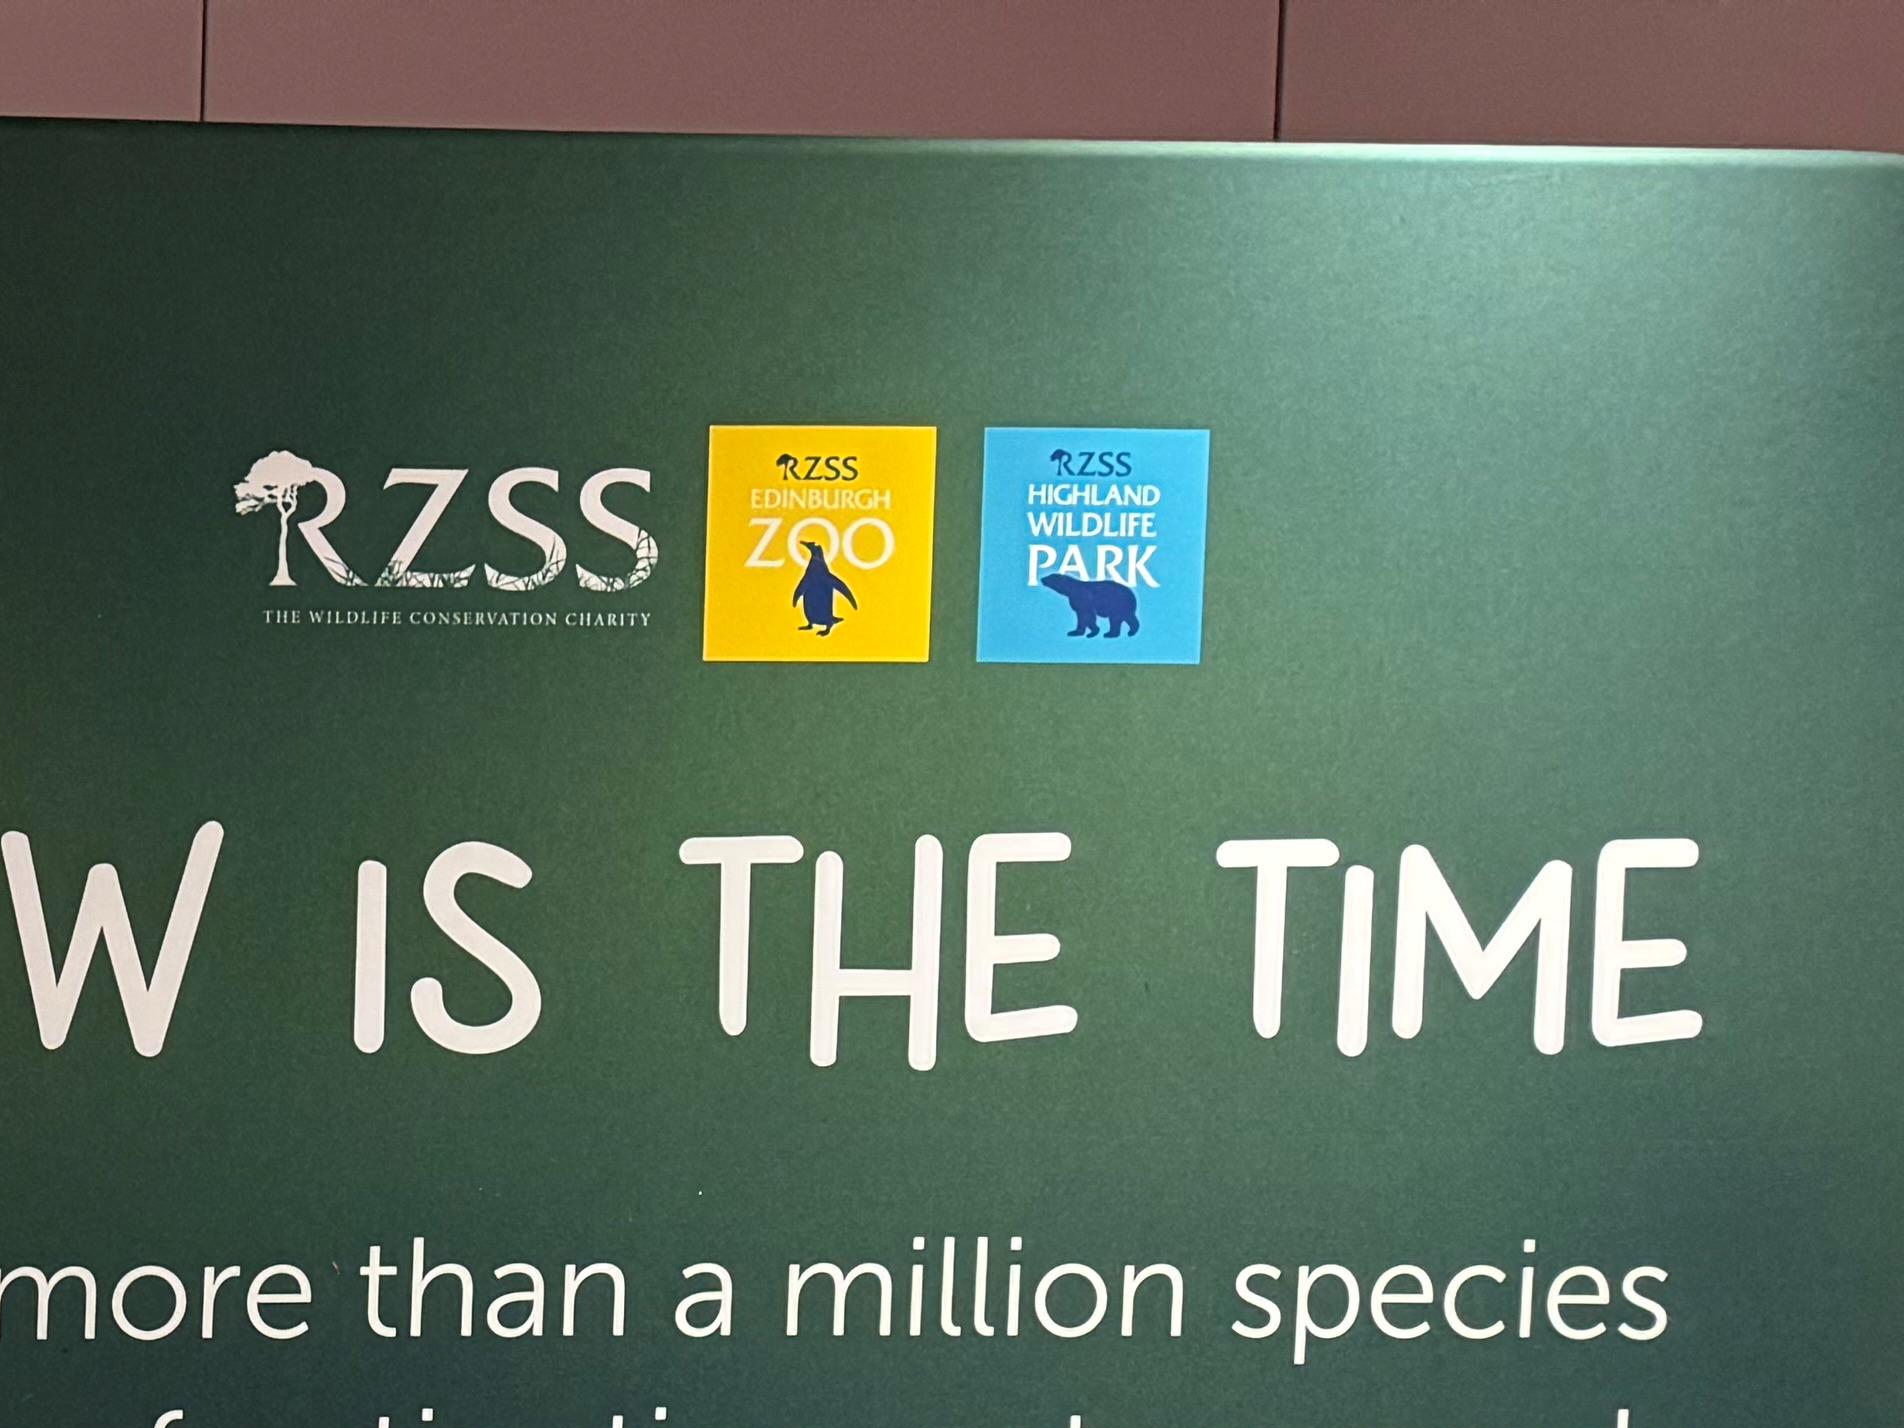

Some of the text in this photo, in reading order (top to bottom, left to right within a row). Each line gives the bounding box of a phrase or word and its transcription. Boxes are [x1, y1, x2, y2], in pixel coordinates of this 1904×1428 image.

[777, 454, 857, 480] RZSS
[1051, 450, 1130, 476] RZSS
[751, 487, 891, 512] EDINBURGH
[1029, 485, 1160, 505] HIGHLAND
[234, 451, 658, 592] RZSS
[1029, 513, 1154, 536] WILDLIFE
[743, 518, 896, 573] ZOO
[1029, 545, 1158, 587] PARK
[263, 611, 650, 626] THE WILDLIFE CONSERVATION CHARITY
[354, 842, 541, 1054] IS
[679, 832, 1078, 1071] THE
[1216, 838, 1703, 1057] TIME
[360, 1237, 625, 1337] than
[675, 1263, 732, 1337] a
[787, 1237, 1183, 1337] million
[1232, 1239, 1668, 1364] species
